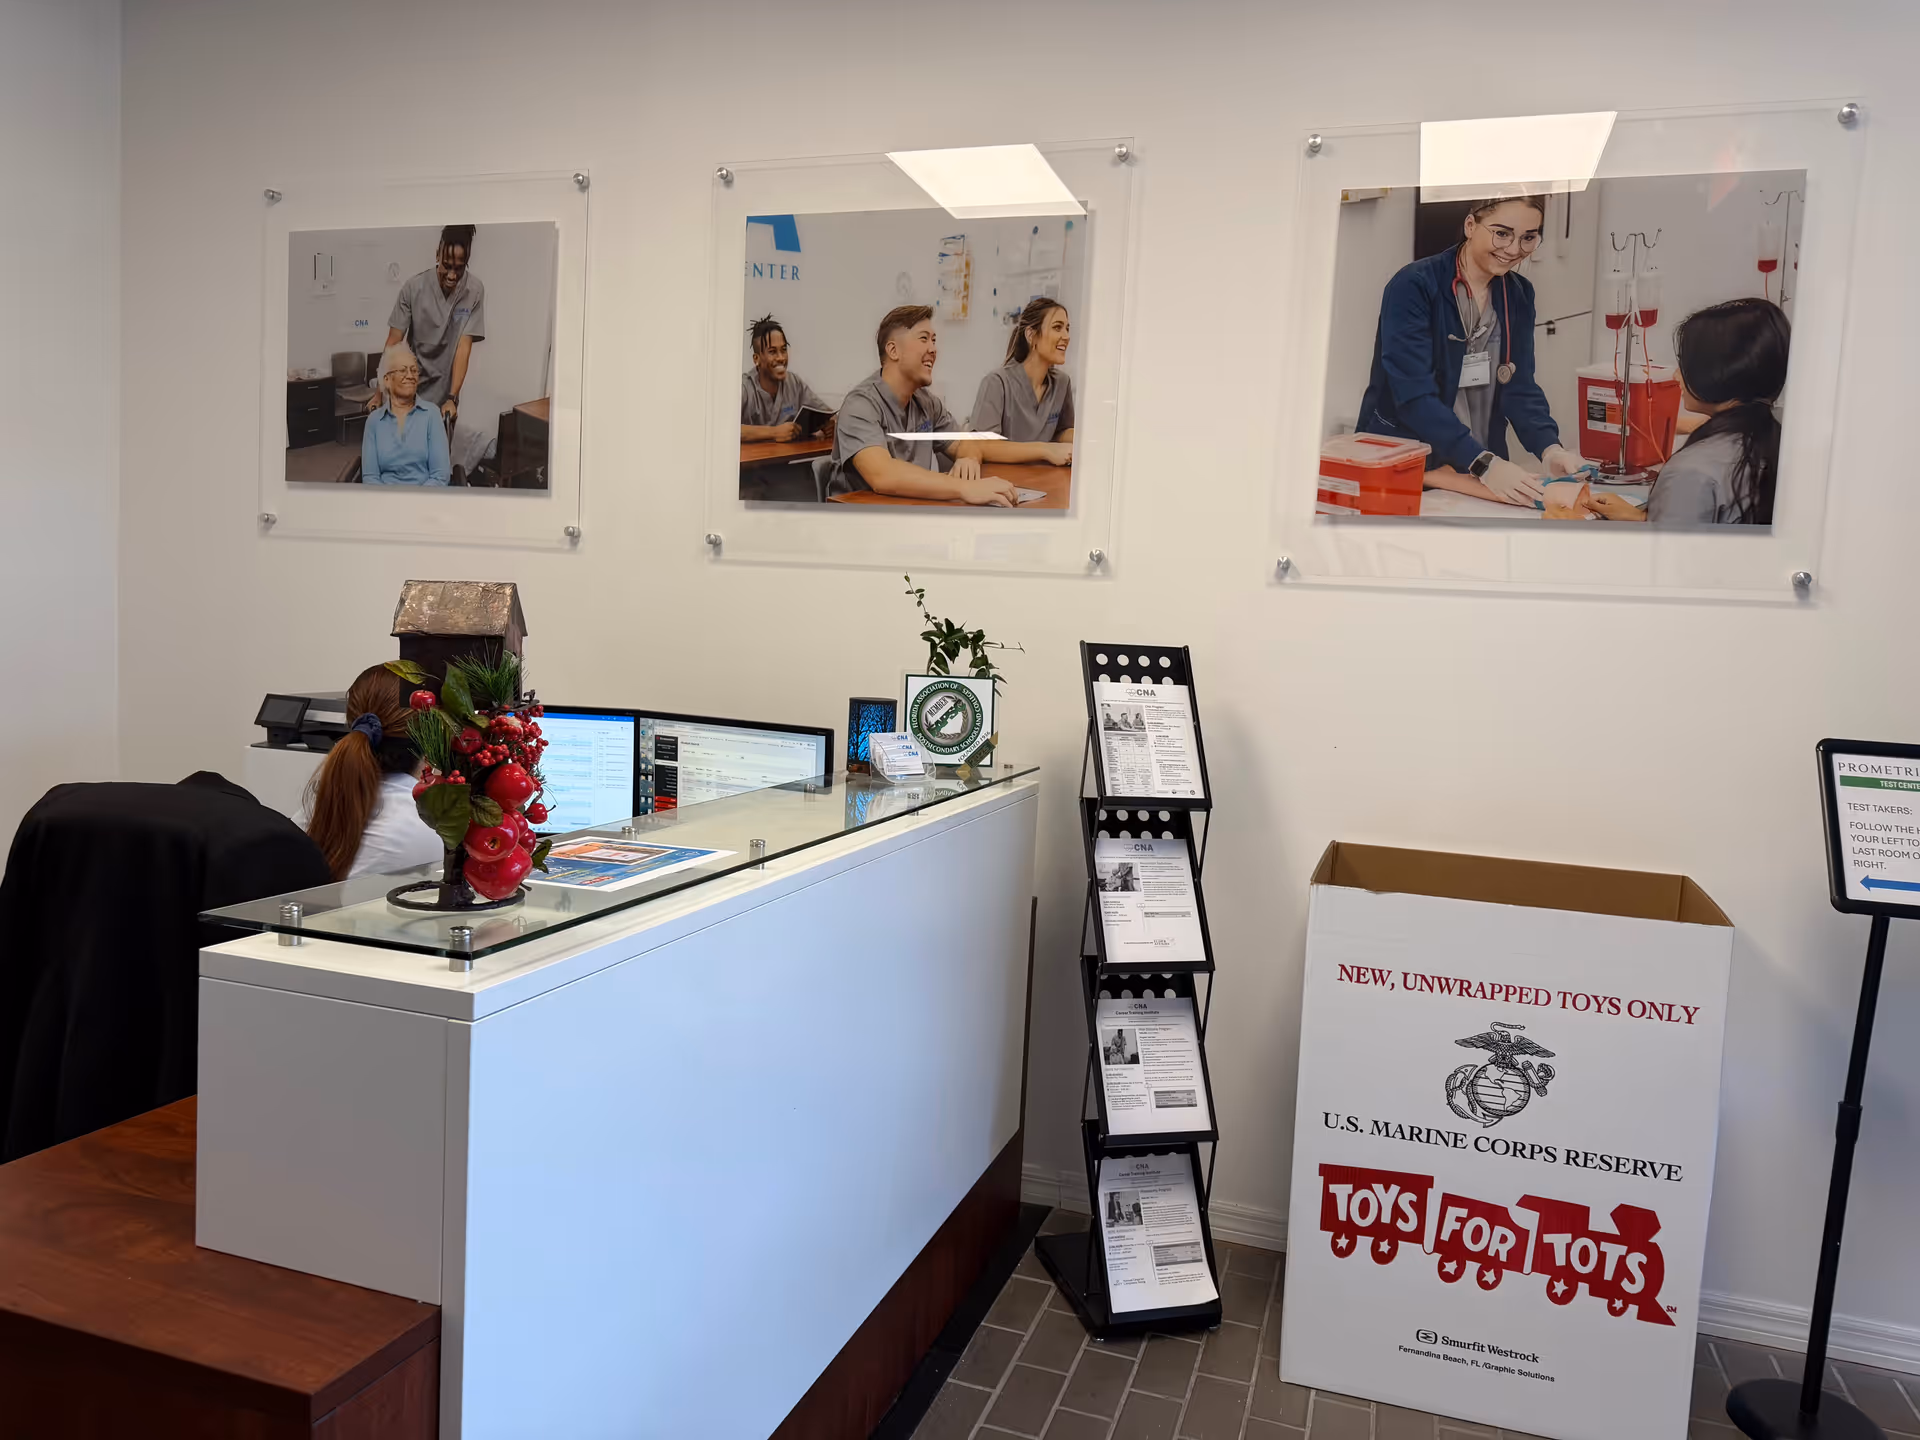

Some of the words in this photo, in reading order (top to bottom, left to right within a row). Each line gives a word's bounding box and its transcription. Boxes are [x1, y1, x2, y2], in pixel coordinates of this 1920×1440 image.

[916, 682, 949, 705] ASSOCIATION
[926, 697, 949, 718] MEMBER
[916, 733, 960, 754] POSTSECONDARY
[959, 726, 980, 750] SCHOOLS
[957, 741, 981, 762] FOUNDED
[1838, 762, 1920, 776] PROMETRI
[1880, 780, 1897, 788] TEST
[1848, 802, 1871, 812] TEST
[1872, 804, 1913, 815] TAKERS:
[1850, 822, 1893, 832] FOLLOW
[1895, 825, 1914, 834] THE
[1134, 844, 1154, 852] CNA
[1851, 834, 1879, 844] YOUR
[1882, 837, 1904, 846] LEFT
[1907, 839, 1920, 848] TO
[1852, 847, 1876, 856] LAST
[1878, 849, 1910, 859] ROOM
[1854, 860, 1887, 870] RIGHT.
[1337, 964, 1395, 991] NEW,
[1401, 972, 1552, 1008] UNWRAPPED
[1557, 990, 1621, 1016] TOYS
[1627, 999, 1700, 1026] ONLY
[1323, 1112, 1364, 1134] U.S.
[1370, 1118, 1468, 1151] MARINE
[1473, 1135, 1558, 1164] CORPS
[1563, 1148, 1684, 1182] RESERVE
[1328, 1183, 1418, 1233] TOYS
[1440, 1206, 1517, 1262] FOR
[1543, 1232, 1648, 1294] TOTS
[1666, 1304, 1677, 1314] SM
[1441, 1335, 1486, 1354] Smurfit
[1487, 1344, 1540, 1364] Westrock
[1398, 1345, 1441, 1360] Fernandina
[1442, 1354, 1469, 1366] Beach,
[1482, 1362, 1516, 1375] /Graphic
[1517, 1368, 1555, 1382] Solutions
